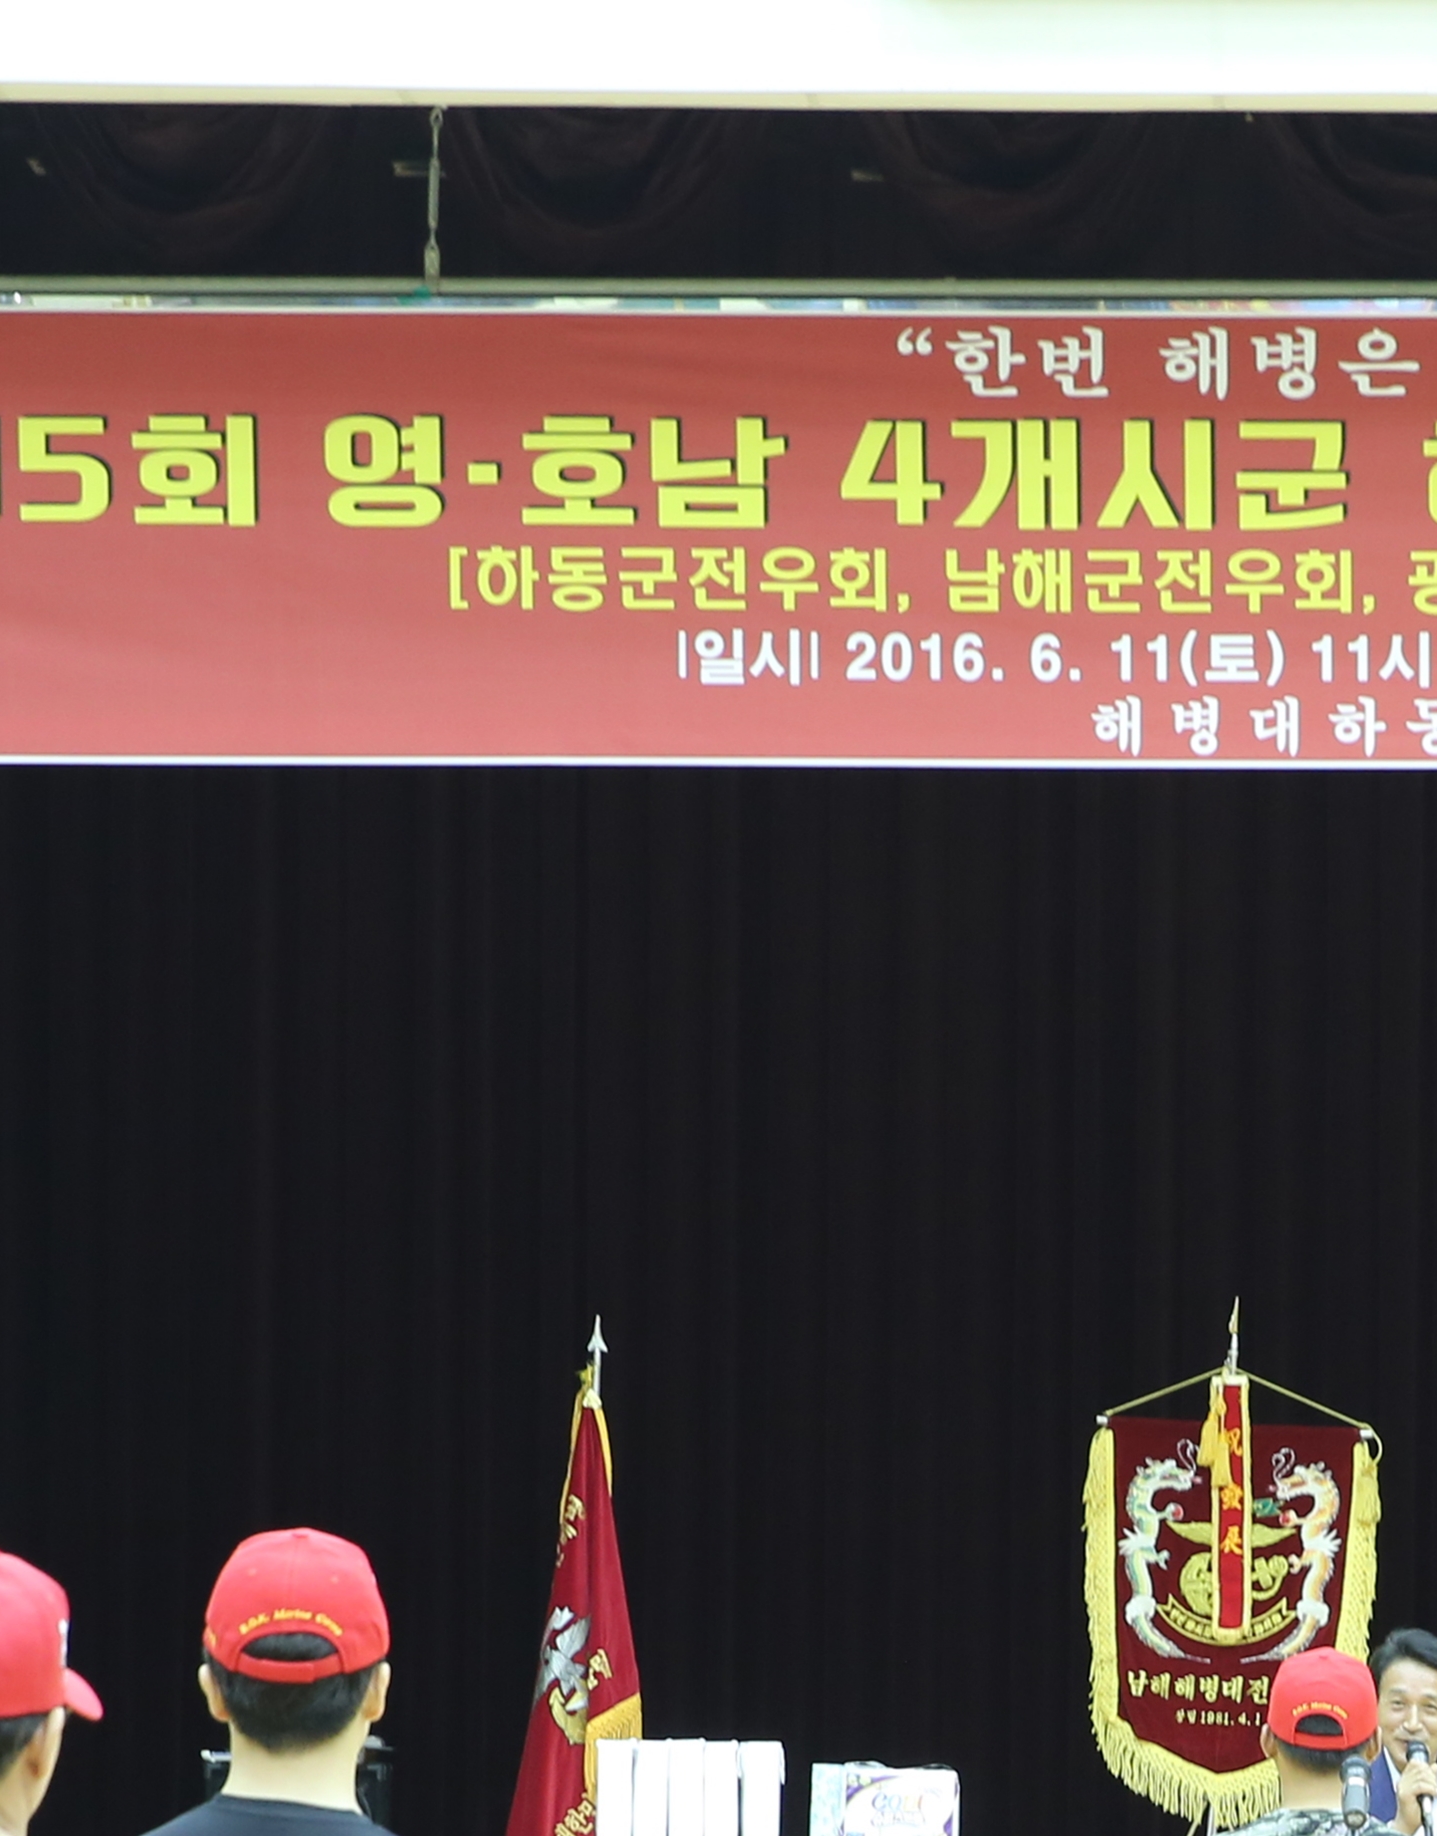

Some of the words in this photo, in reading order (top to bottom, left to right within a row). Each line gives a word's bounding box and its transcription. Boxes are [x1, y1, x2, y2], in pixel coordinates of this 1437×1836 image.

[1159, 328, 1420, 399] 해병은
[840, 419, 1347, 531] 4개시군
[945, 549, 1375, 616] 남해군전우회,
[845, 632, 1004, 683] 2016.
[1030, 633, 1082, 683] 6.
[1110, 630, 1285, 687] 11(토)
[1311, 631, 1431, 688] 11시
